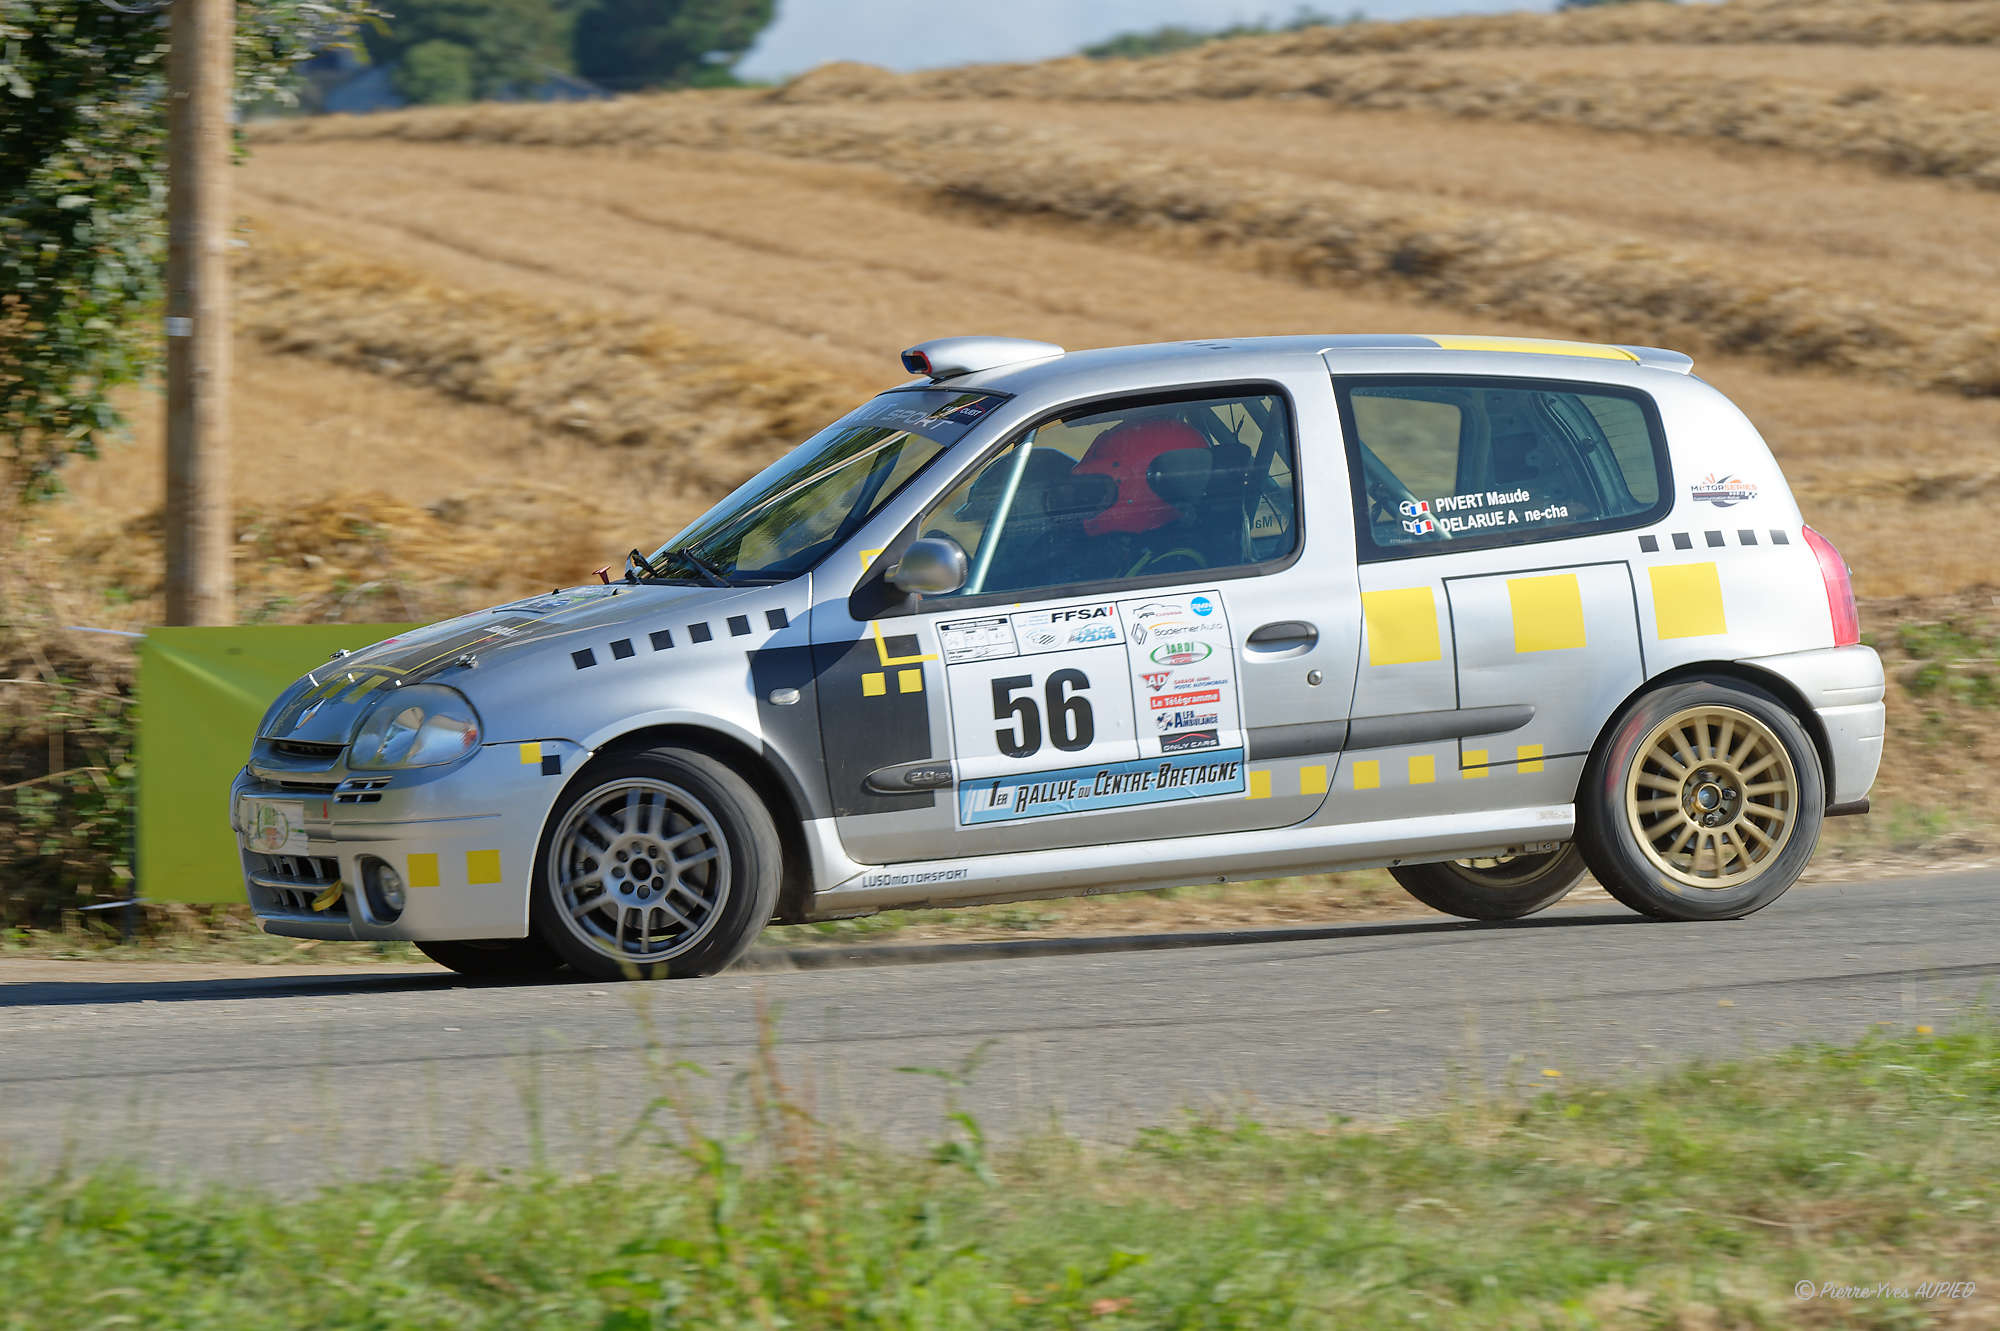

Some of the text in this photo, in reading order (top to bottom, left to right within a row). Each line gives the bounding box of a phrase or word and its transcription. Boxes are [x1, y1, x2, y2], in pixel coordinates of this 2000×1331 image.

[1435, 488, 1530, 513] PIVERT Maude
[1440, 511, 1506, 533] DELARUE
[1051, 607, 1107, 623] FFSA
[1146, 674, 1168, 689] AD
[1151, 692, 1218, 708] Le Télégramme
[991, 667, 1095, 759] 56
[1190, 739, 1217, 748] CARS
[1014, 779, 1079, 813] RALLYE
